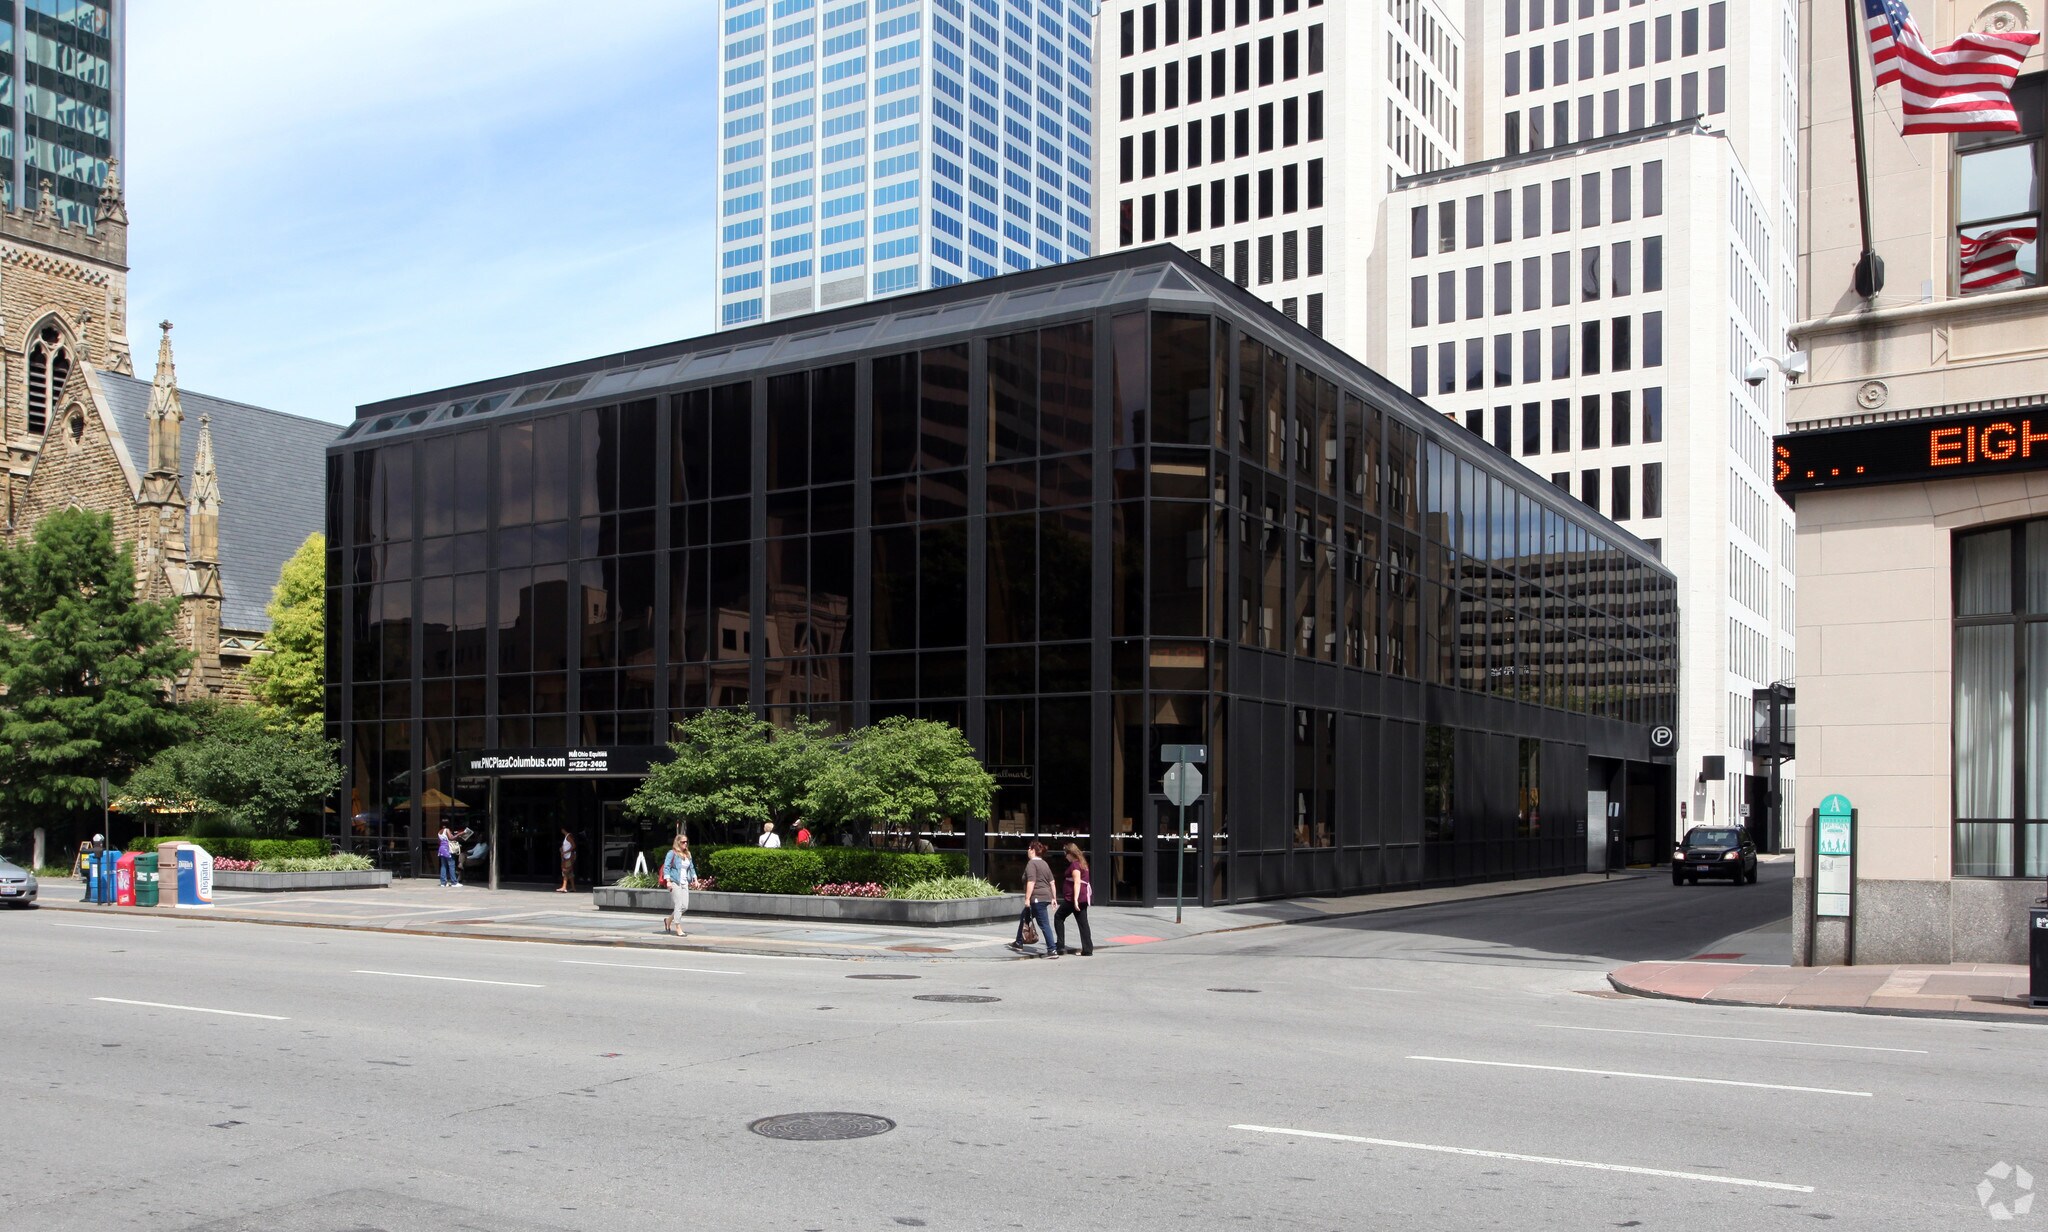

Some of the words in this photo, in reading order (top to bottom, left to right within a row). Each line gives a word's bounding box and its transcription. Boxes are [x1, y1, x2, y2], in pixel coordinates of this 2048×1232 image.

[1930, 420, 2048, 466] EIGH
[471, 756, 565, 769] www.PNCPlazaColumbus.com
[1830, 796, 1840, 812] A
